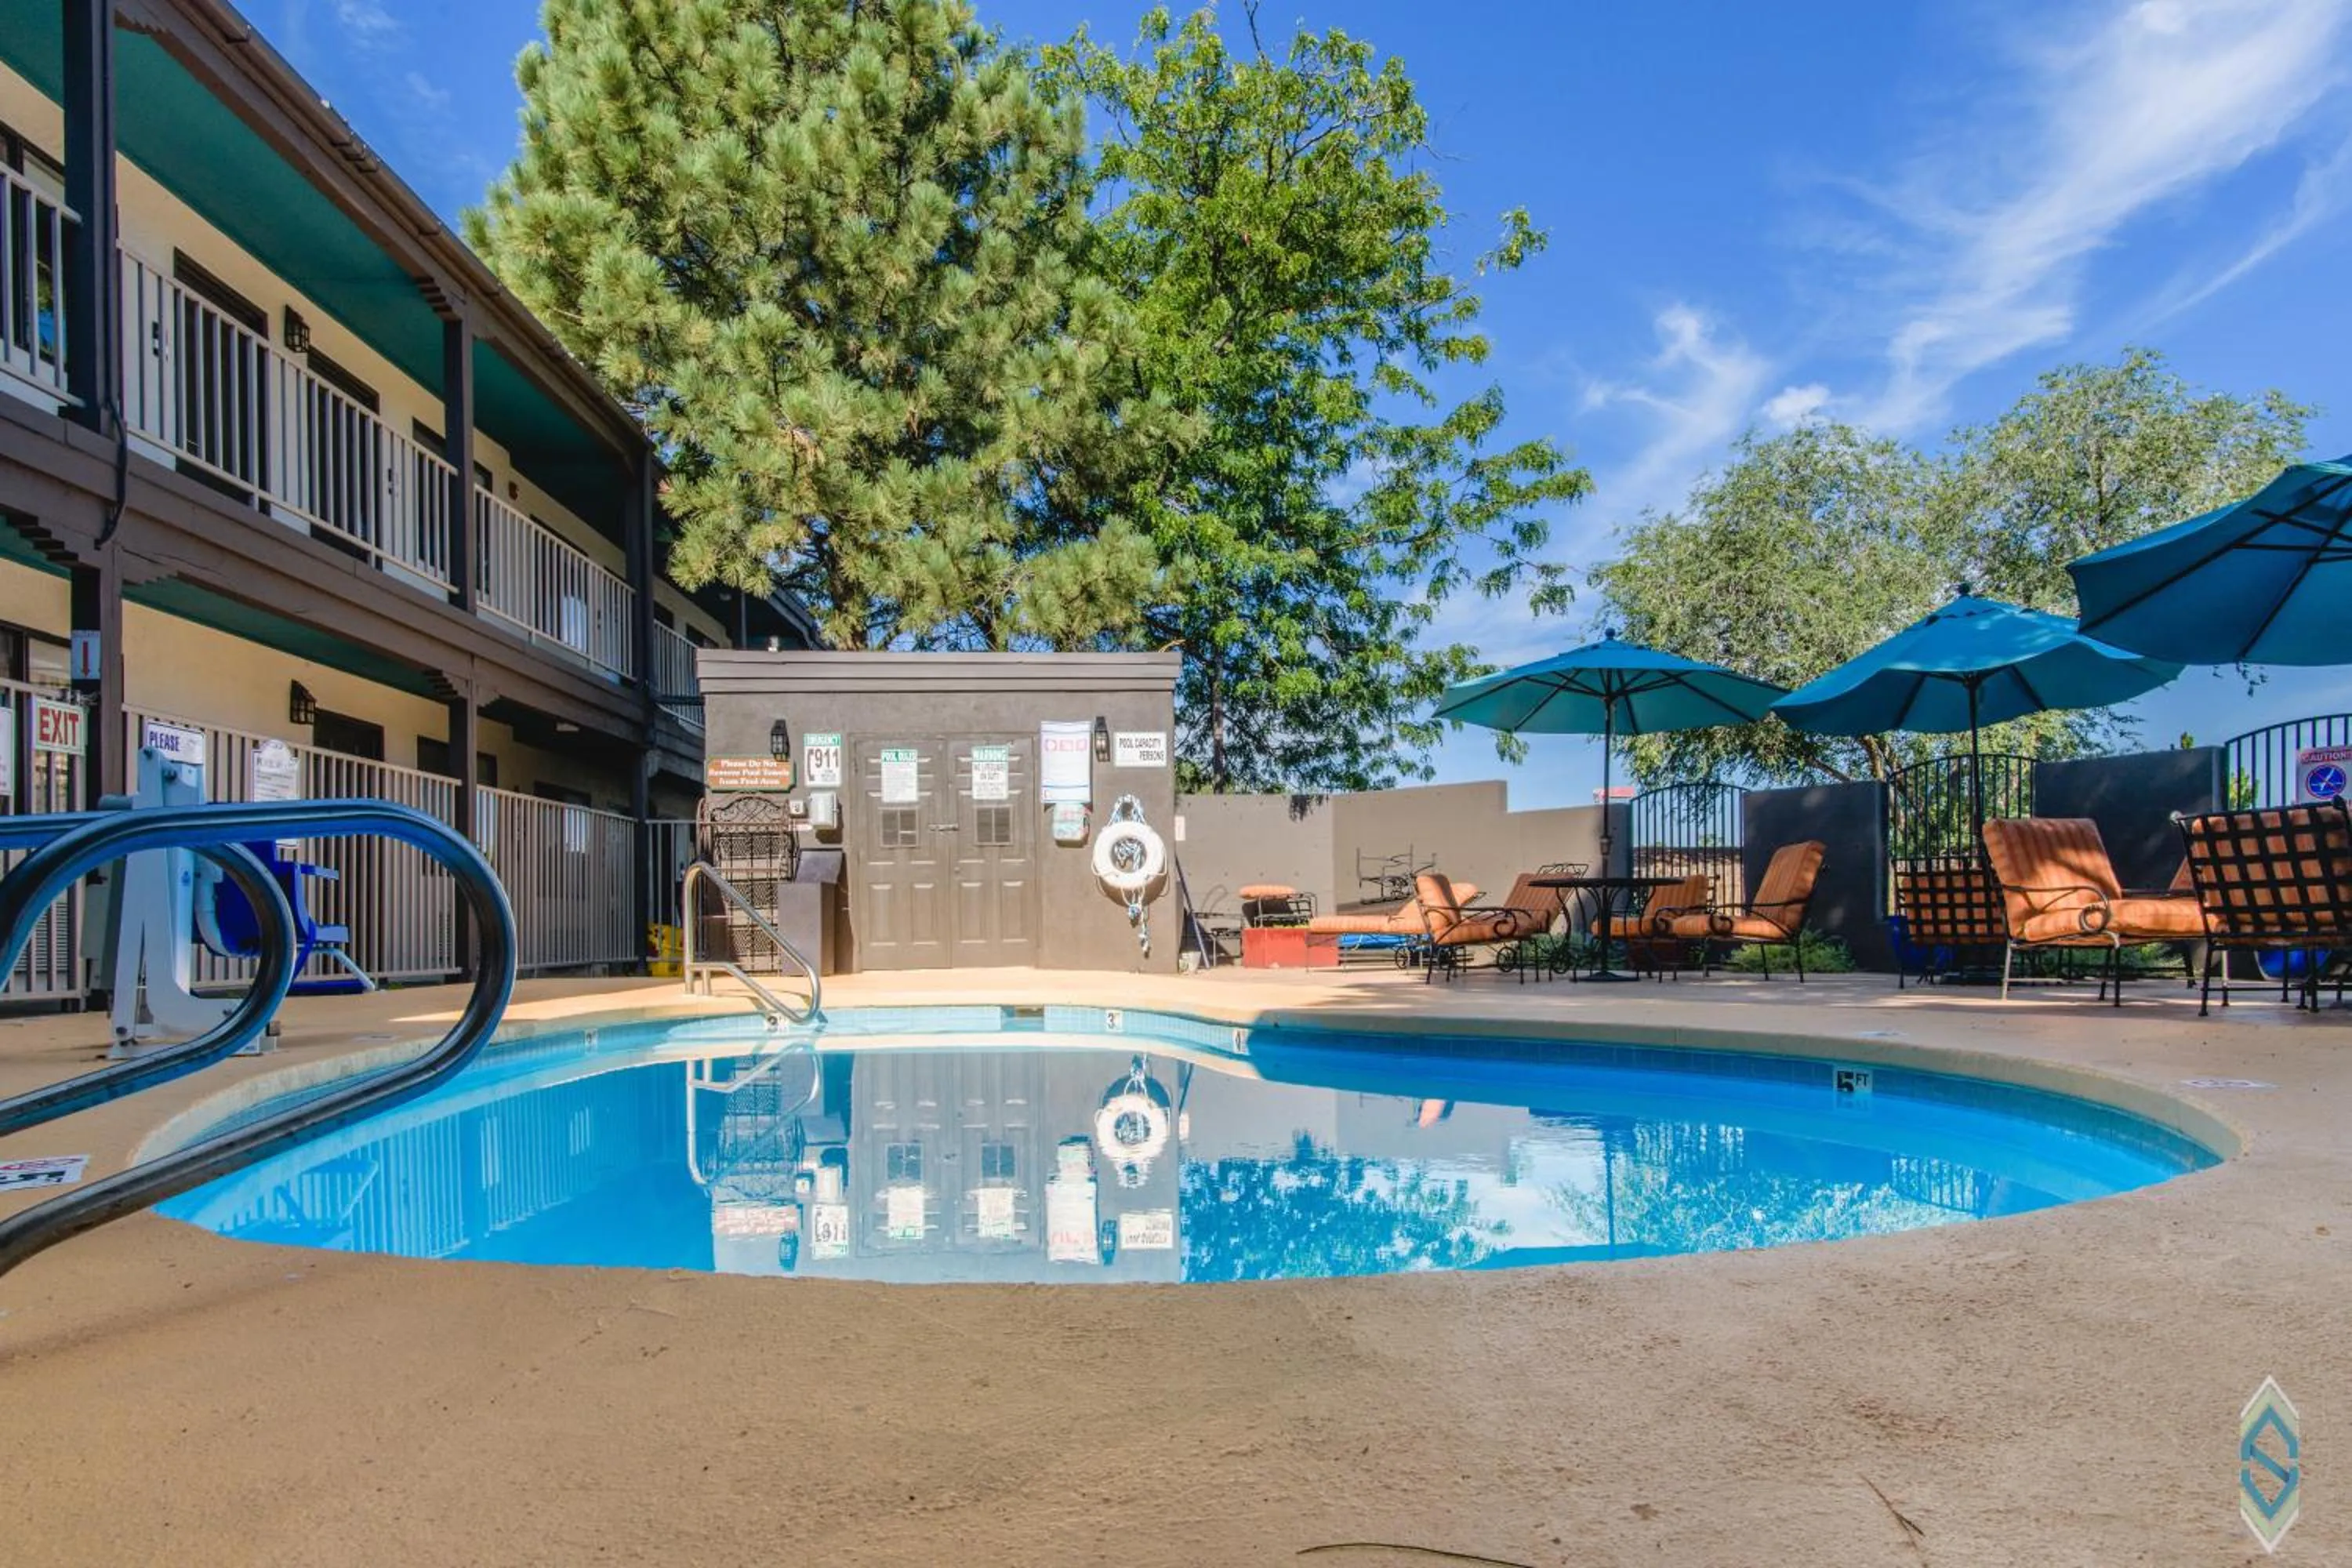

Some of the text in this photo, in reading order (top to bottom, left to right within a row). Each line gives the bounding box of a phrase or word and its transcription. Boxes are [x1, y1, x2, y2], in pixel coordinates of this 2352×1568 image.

[38, 706, 79, 746] EXIT
[149, 731, 180, 752] PLEASE
[1120, 738, 1134, 748] POOL
[749, 759, 761, 768] Do
[763, 759, 778, 768] Not
[815, 749, 839, 768] 911
[1837, 1070, 1869, 1093] 5 FT
